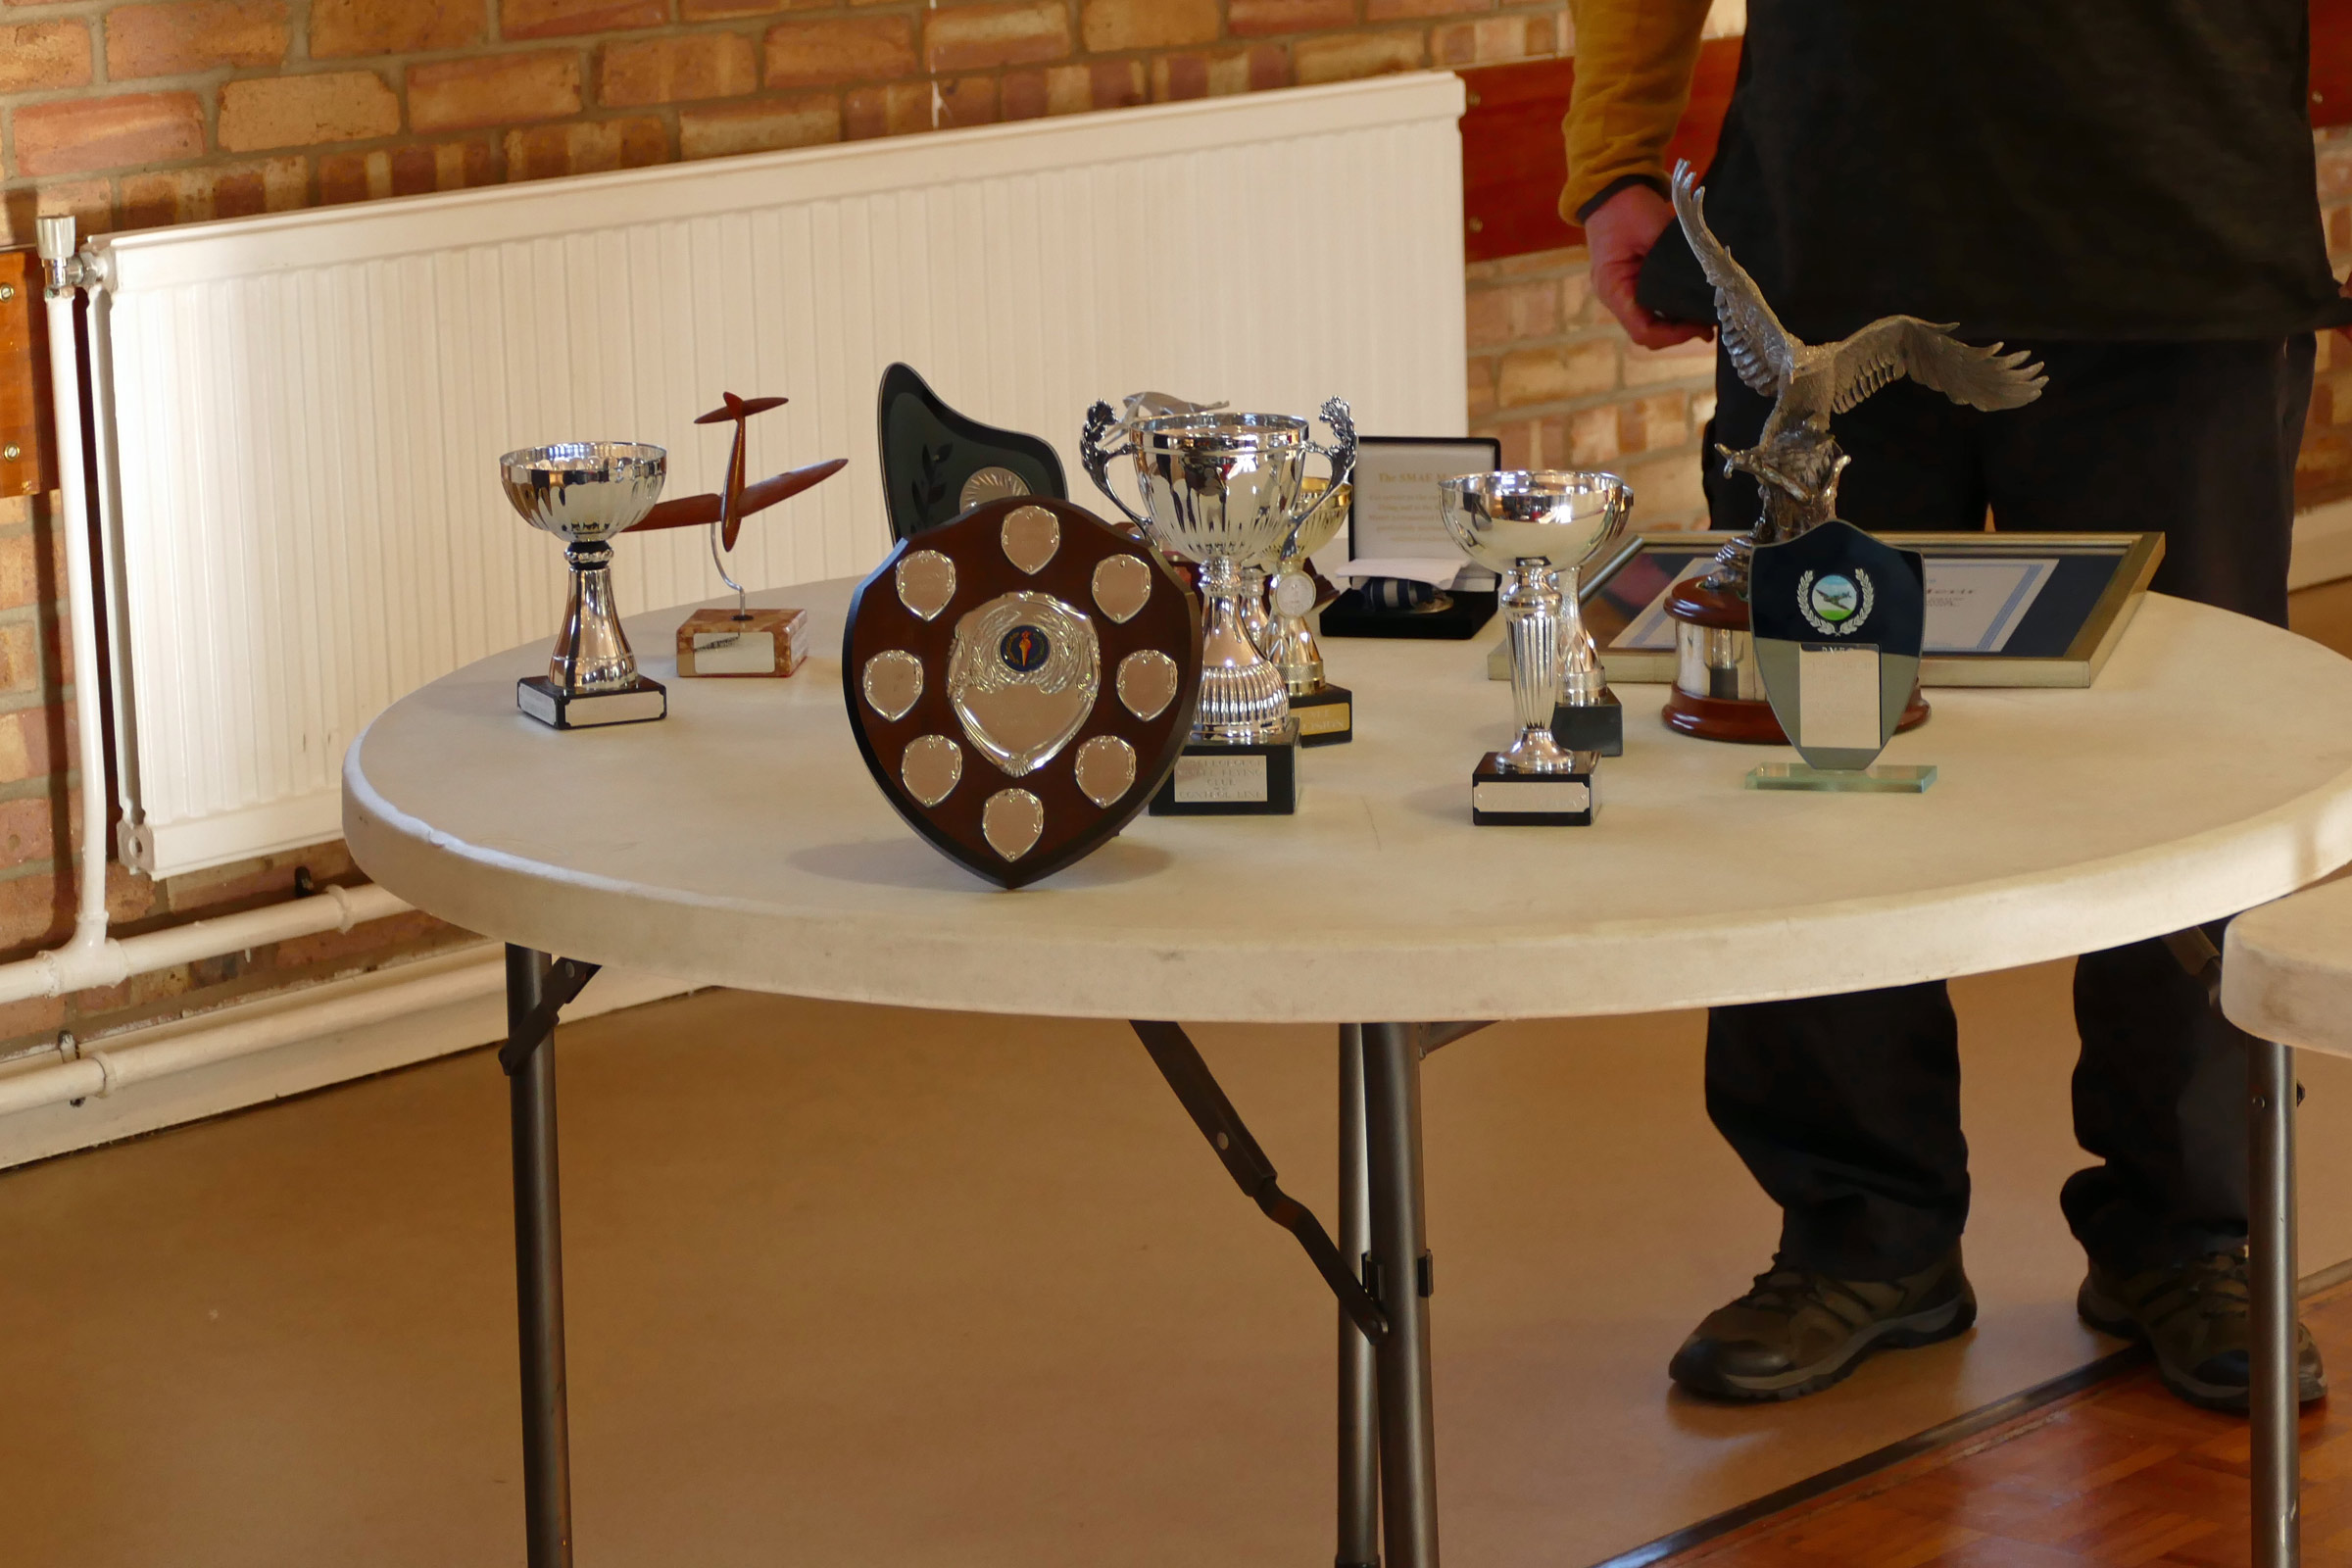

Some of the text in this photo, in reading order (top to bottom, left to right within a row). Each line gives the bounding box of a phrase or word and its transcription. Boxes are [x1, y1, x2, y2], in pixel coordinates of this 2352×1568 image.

[1379, 472, 1396, 482] The
[1206, 778, 1236, 787] CLUB
[1179, 791, 1262, 800] CONTROL LINE
